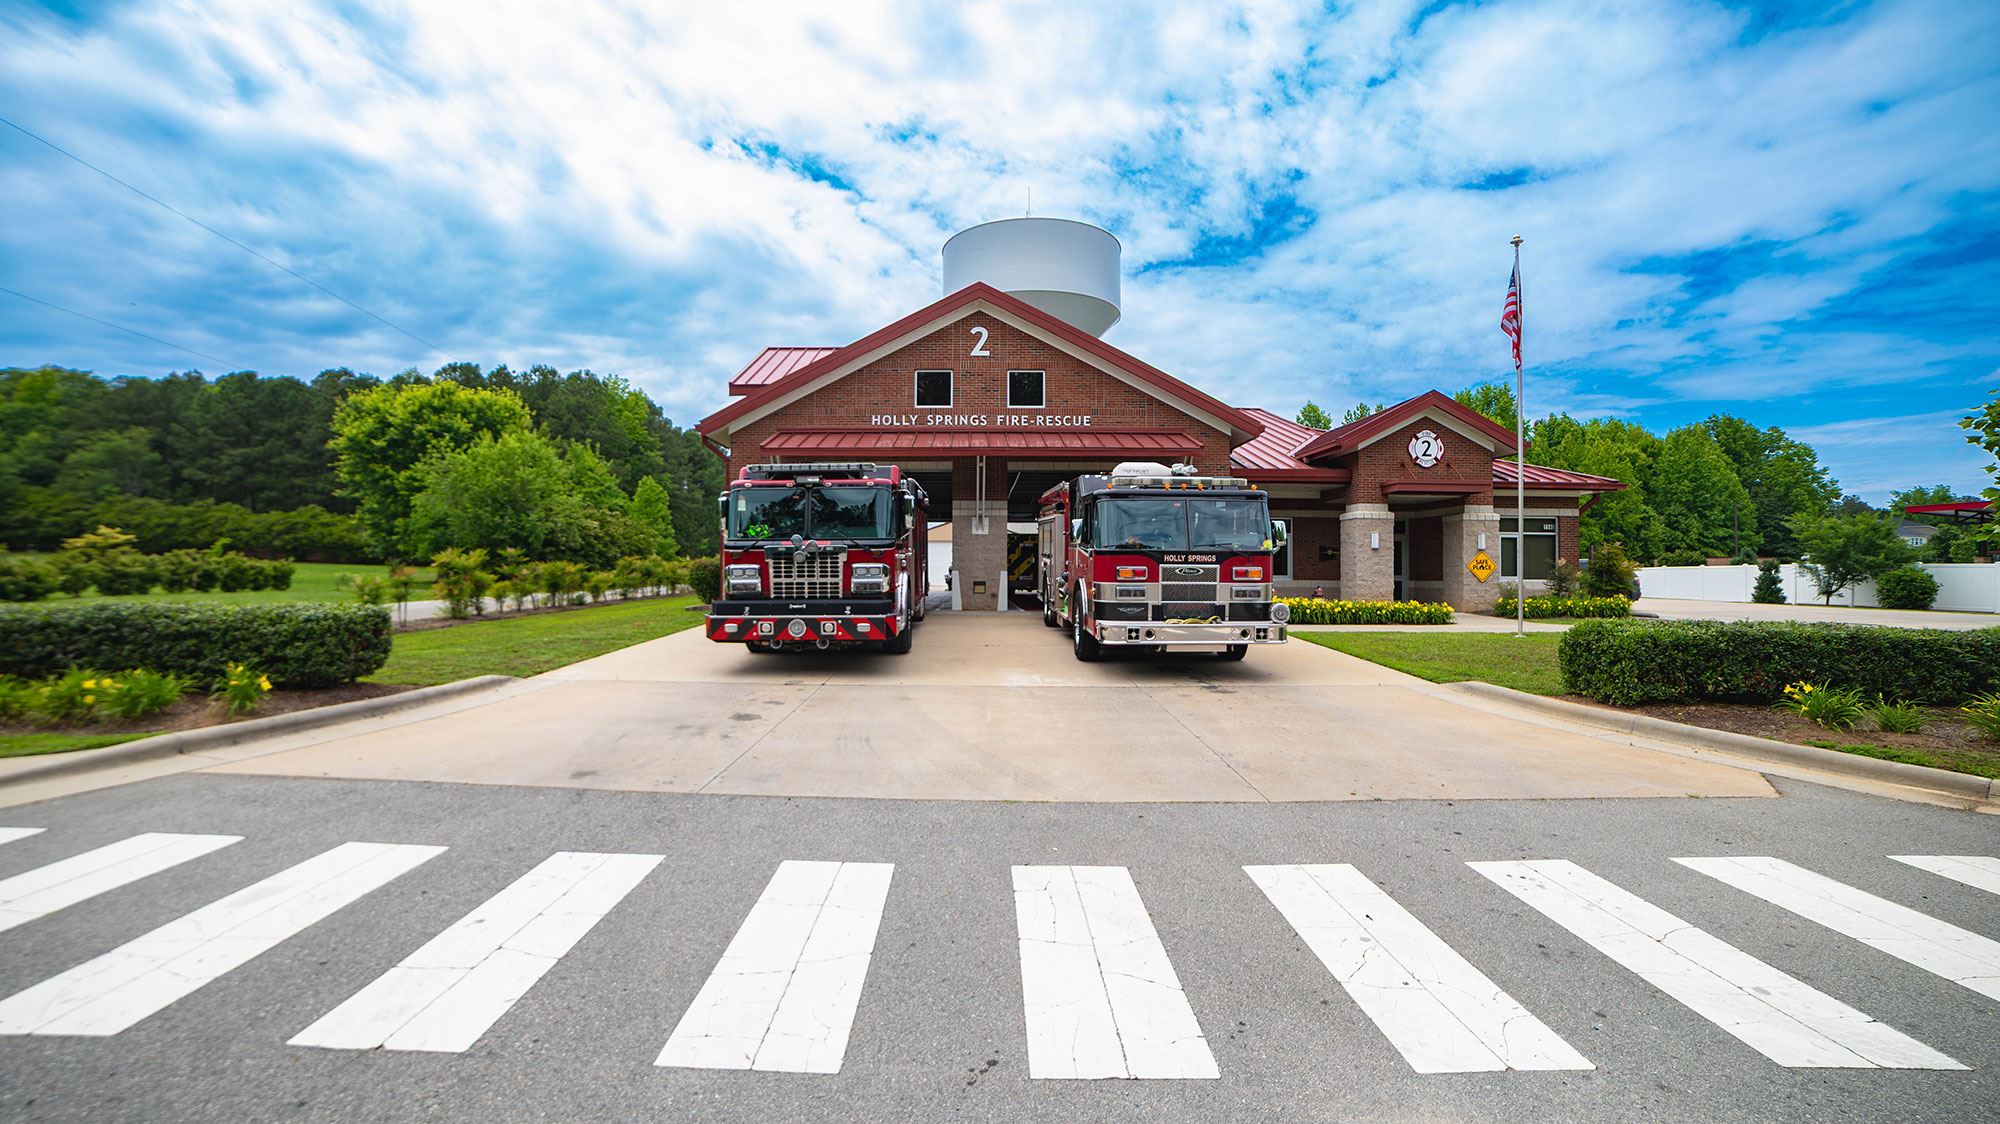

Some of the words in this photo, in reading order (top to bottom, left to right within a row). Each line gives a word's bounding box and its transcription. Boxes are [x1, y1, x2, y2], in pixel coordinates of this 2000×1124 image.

[969, 326, 991, 357] 2
[871, 414, 918, 426] HOLLY
[926, 414, 988, 427] SPRINGS
[997, 415, 1091, 427] FIRE-RESCUE
[1421, 440, 1432, 457] 2
[1163, 554, 1186, 562] HOLLY
[1187, 554, 1217, 562] SPRINGS
